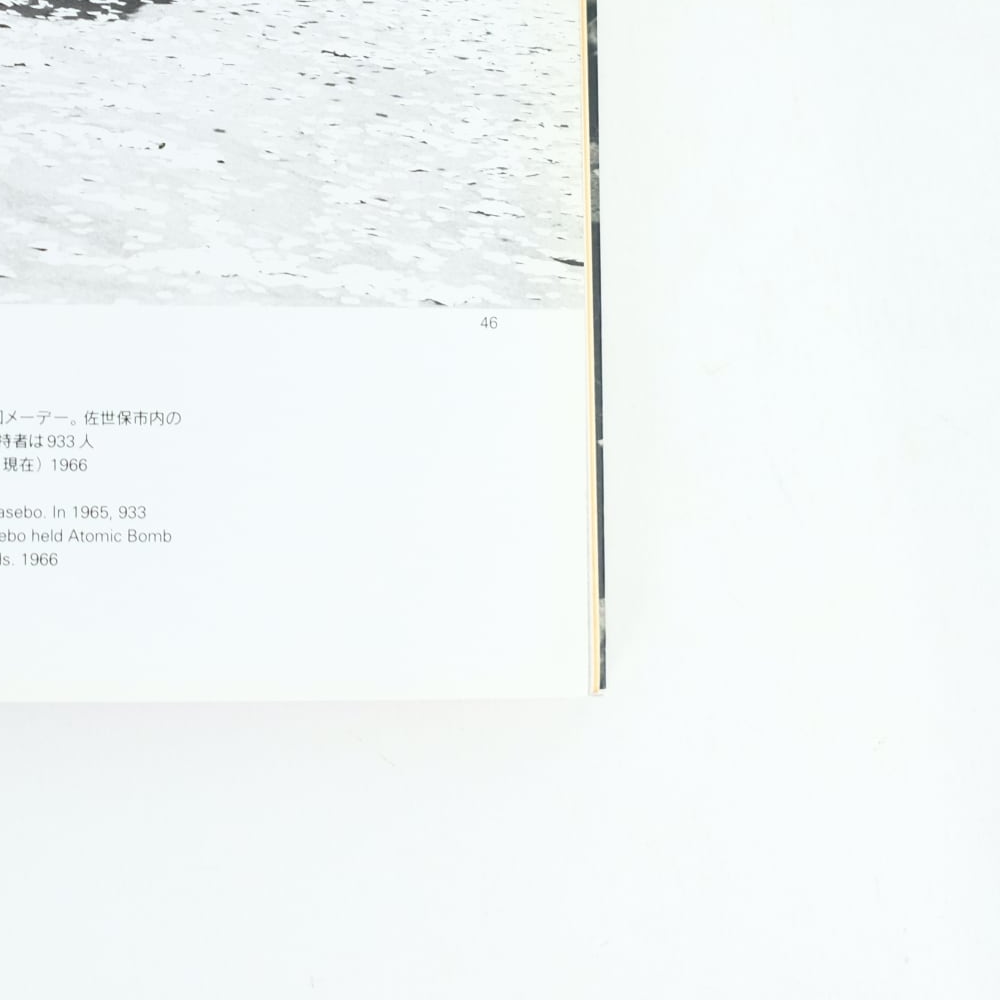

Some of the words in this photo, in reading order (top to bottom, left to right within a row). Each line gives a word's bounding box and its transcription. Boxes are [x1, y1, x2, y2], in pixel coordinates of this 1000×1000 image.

[480, 316, 498, 330] 46
[52, 457, 88, 472] 1966
[53, 504, 66, 519] In
[73, 505, 113, 521] 1965,
[119, 505, 147, 520] 933
[32, 528, 63, 543] held
[68, 528, 122, 543] Atomic
[127, 528, 173, 543] Bomb
[21, 552, 59, 567] 1966
